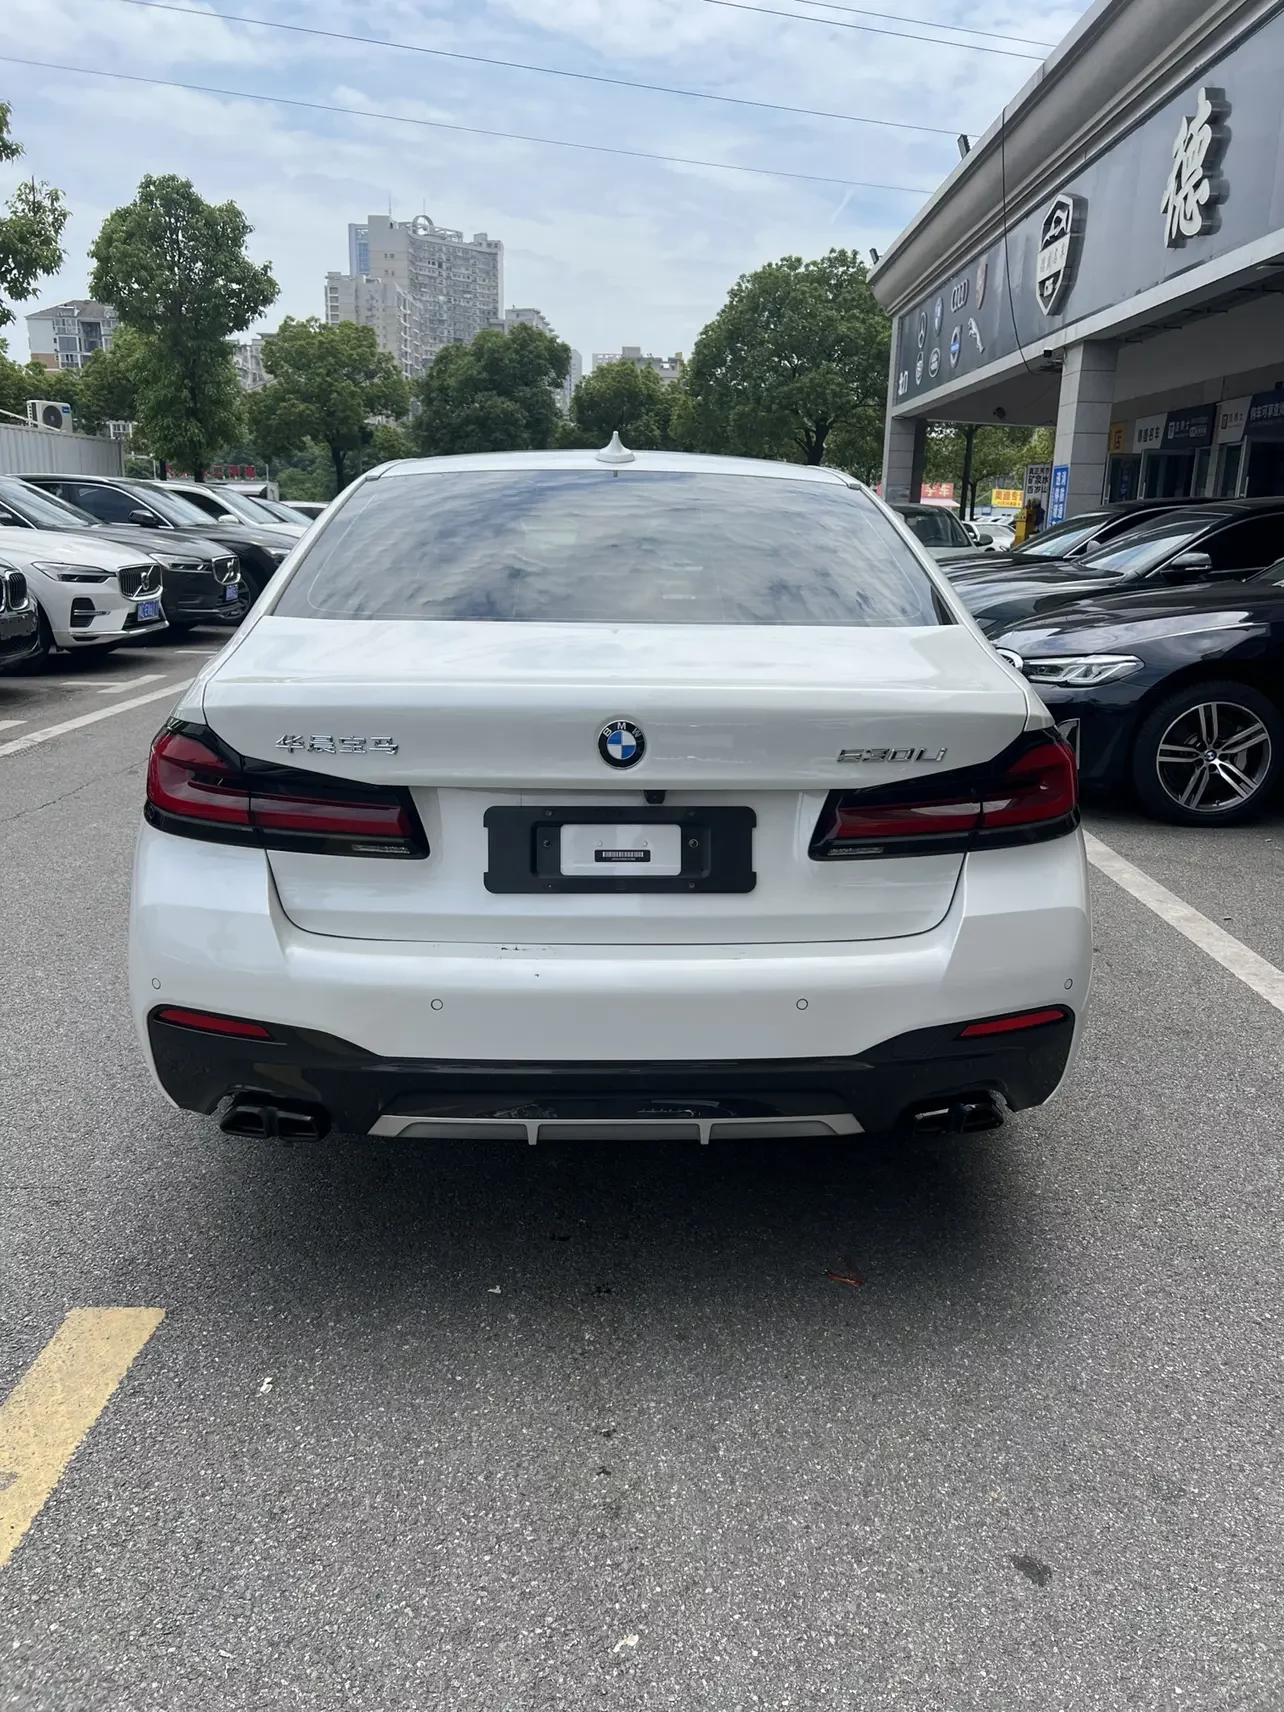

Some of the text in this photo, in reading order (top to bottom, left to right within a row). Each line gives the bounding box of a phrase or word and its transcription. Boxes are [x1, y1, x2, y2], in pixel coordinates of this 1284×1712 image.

[1160, 87, 1214, 248] 德
[1028, 475, 1048, 485] 矿泉水
[602, 722, 642, 738] BMW
[275, 734, 399, 755] 华晨宝马
[837, 747, 947, 763] 530Li
